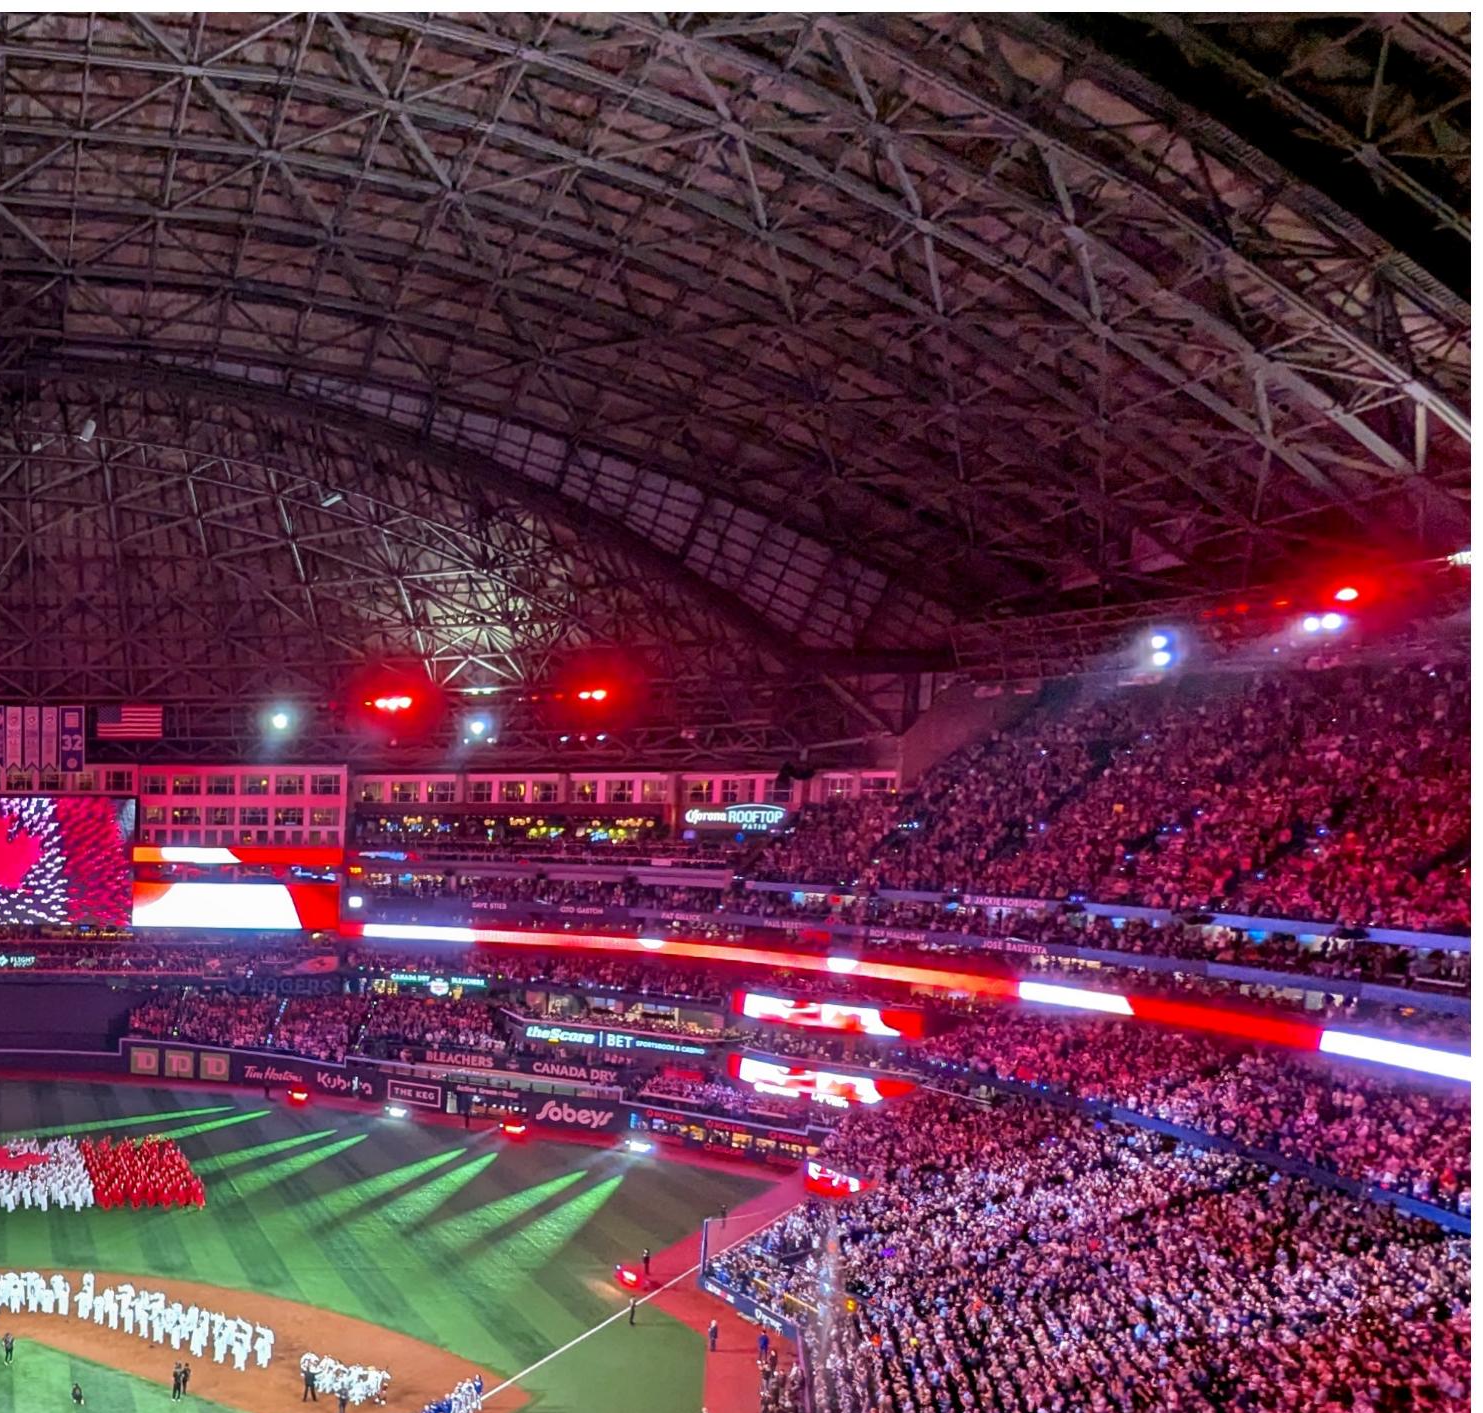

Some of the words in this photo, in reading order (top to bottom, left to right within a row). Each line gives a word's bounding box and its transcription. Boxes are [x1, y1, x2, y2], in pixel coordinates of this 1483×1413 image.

[61, 734, 83, 751] 32
[684, 809, 727, 824] Corona
[727, 809, 784, 824] ROOFTOP
[741, 823, 768, 831] PATIO
[1005, 941, 1048, 955] BAUTISTA
[250, 976, 334, 996] ROGERS
[526, 1024, 595, 1044] theScore
[606, 1033, 634, 1049] BET
[425, 1050, 494, 1069] BLEACHERS
[244, 1065, 264, 1080] Tim
[264, 1066, 304, 1083] Hortons
[532, 1061, 587, 1081] CANADA
[589, 1068, 617, 1083] DRY
[393, 1086, 413, 1098] THE
[415, 1089, 435, 1101] KEG
[535, 1099, 614, 1129] Sobeys
